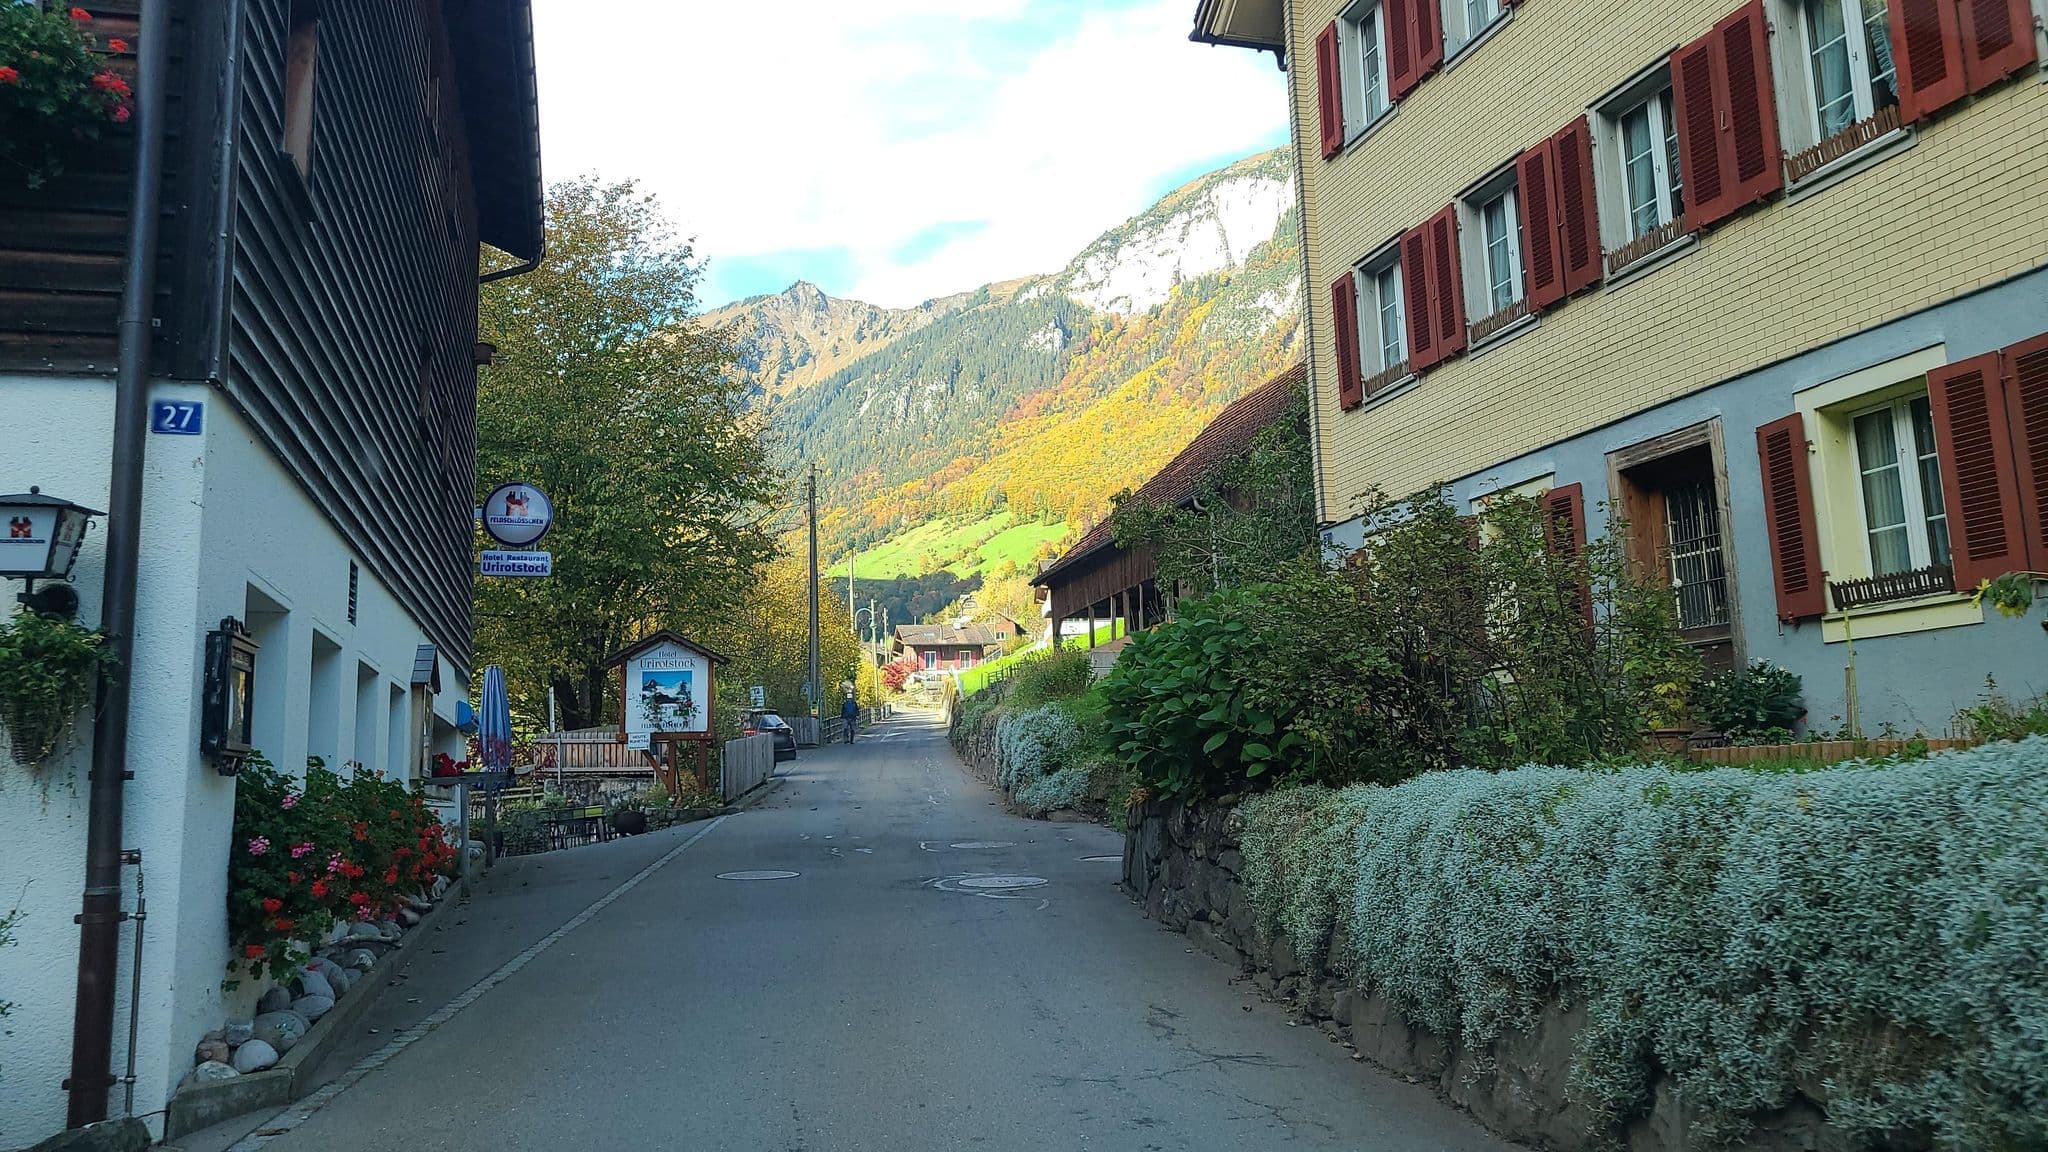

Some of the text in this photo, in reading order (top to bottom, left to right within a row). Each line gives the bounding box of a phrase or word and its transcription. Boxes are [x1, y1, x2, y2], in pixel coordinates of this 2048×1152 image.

[162, 405, 194, 429] 27
[507, 554, 549, 562] Restaurant
[483, 561, 548, 573] Urirotstock
[659, 650, 678, 658] Hotel
[640, 658, 696, 669] Urirotstock
